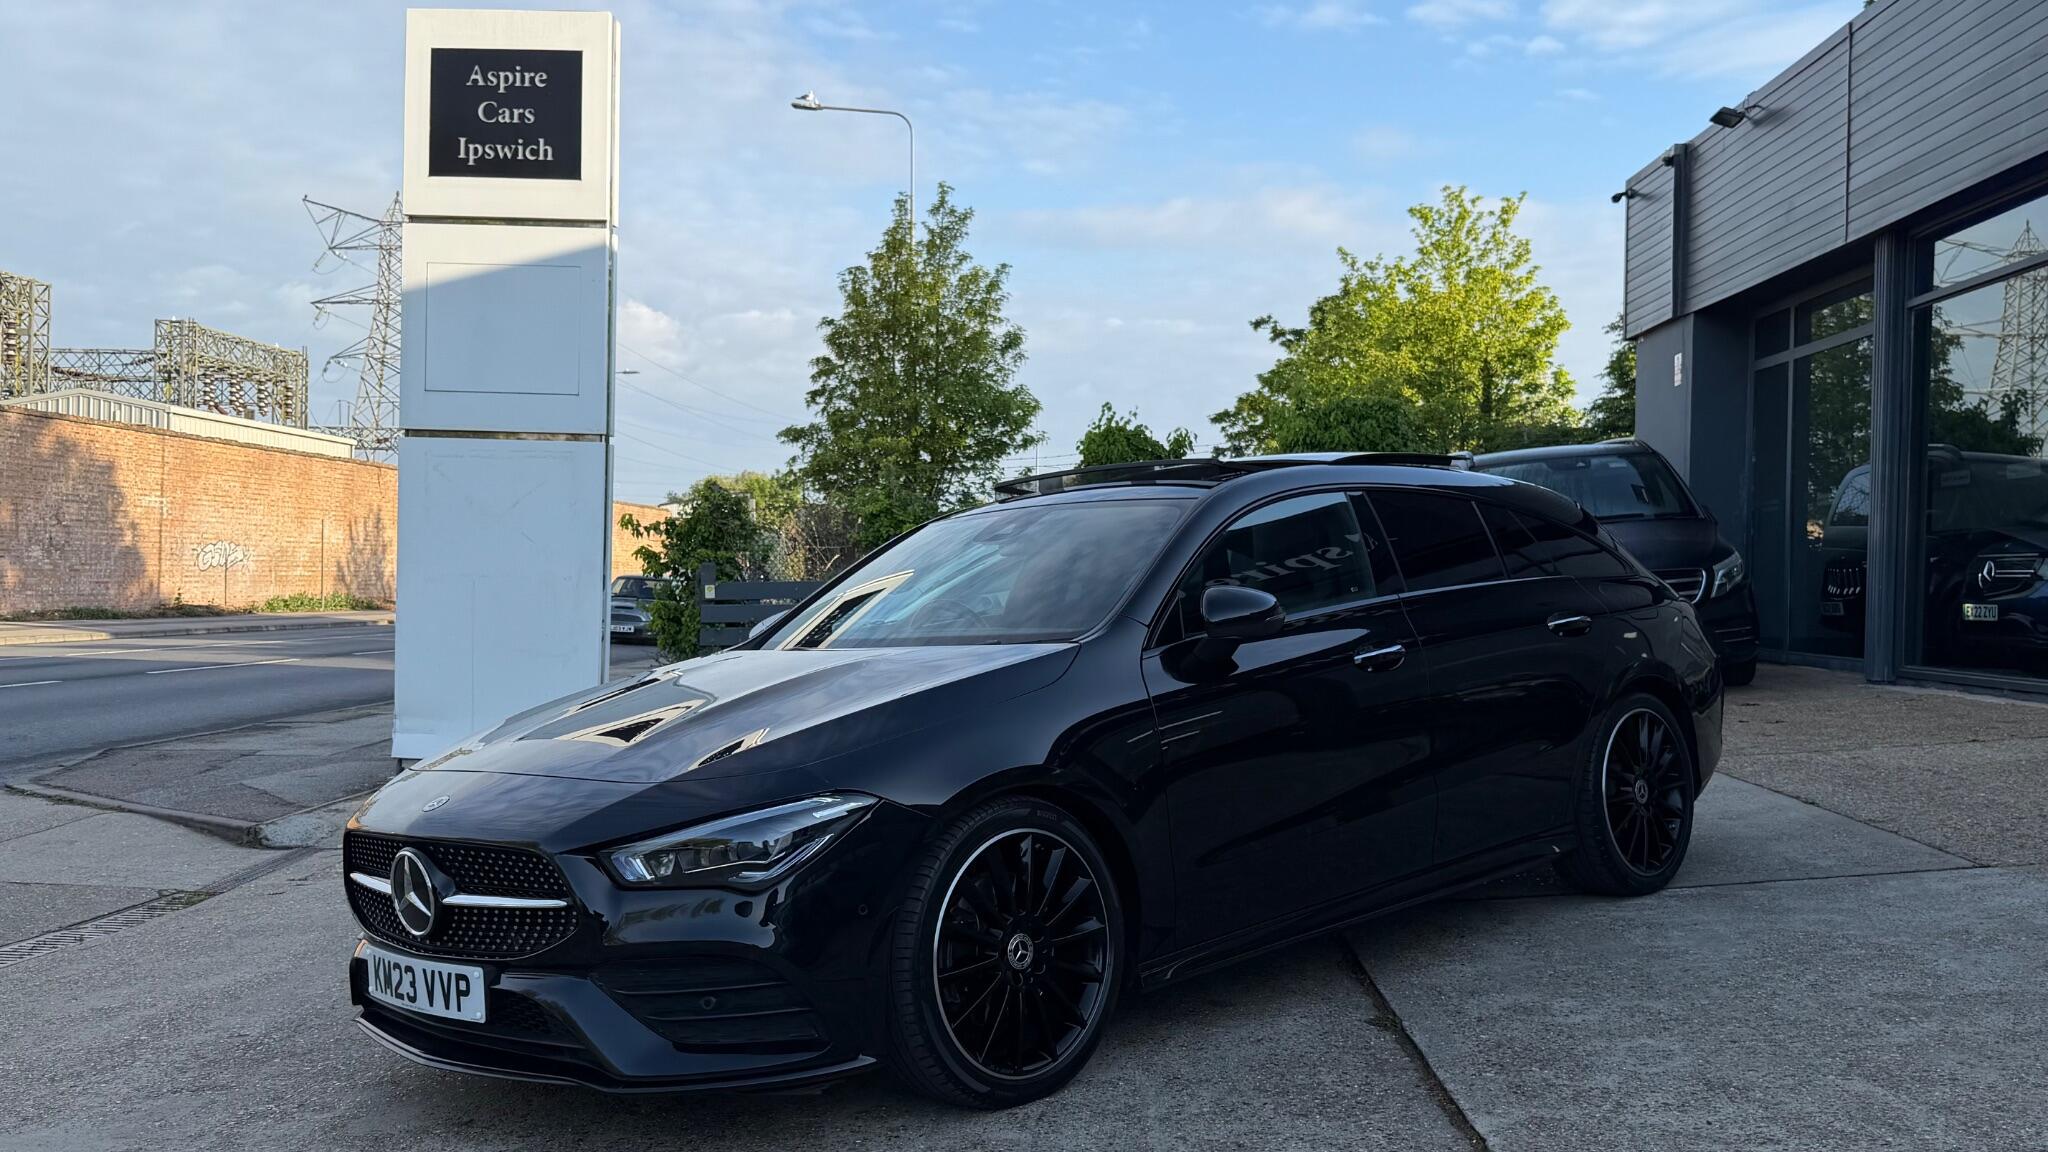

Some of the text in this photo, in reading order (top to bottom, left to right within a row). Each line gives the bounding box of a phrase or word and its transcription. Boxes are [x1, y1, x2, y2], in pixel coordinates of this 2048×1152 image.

[466, 65, 548, 93] Aspire
[478, 101, 535, 124] Cars
[458, 136, 554, 165] Ipswich
[373, 954, 471, 1012] KM23 VVP
